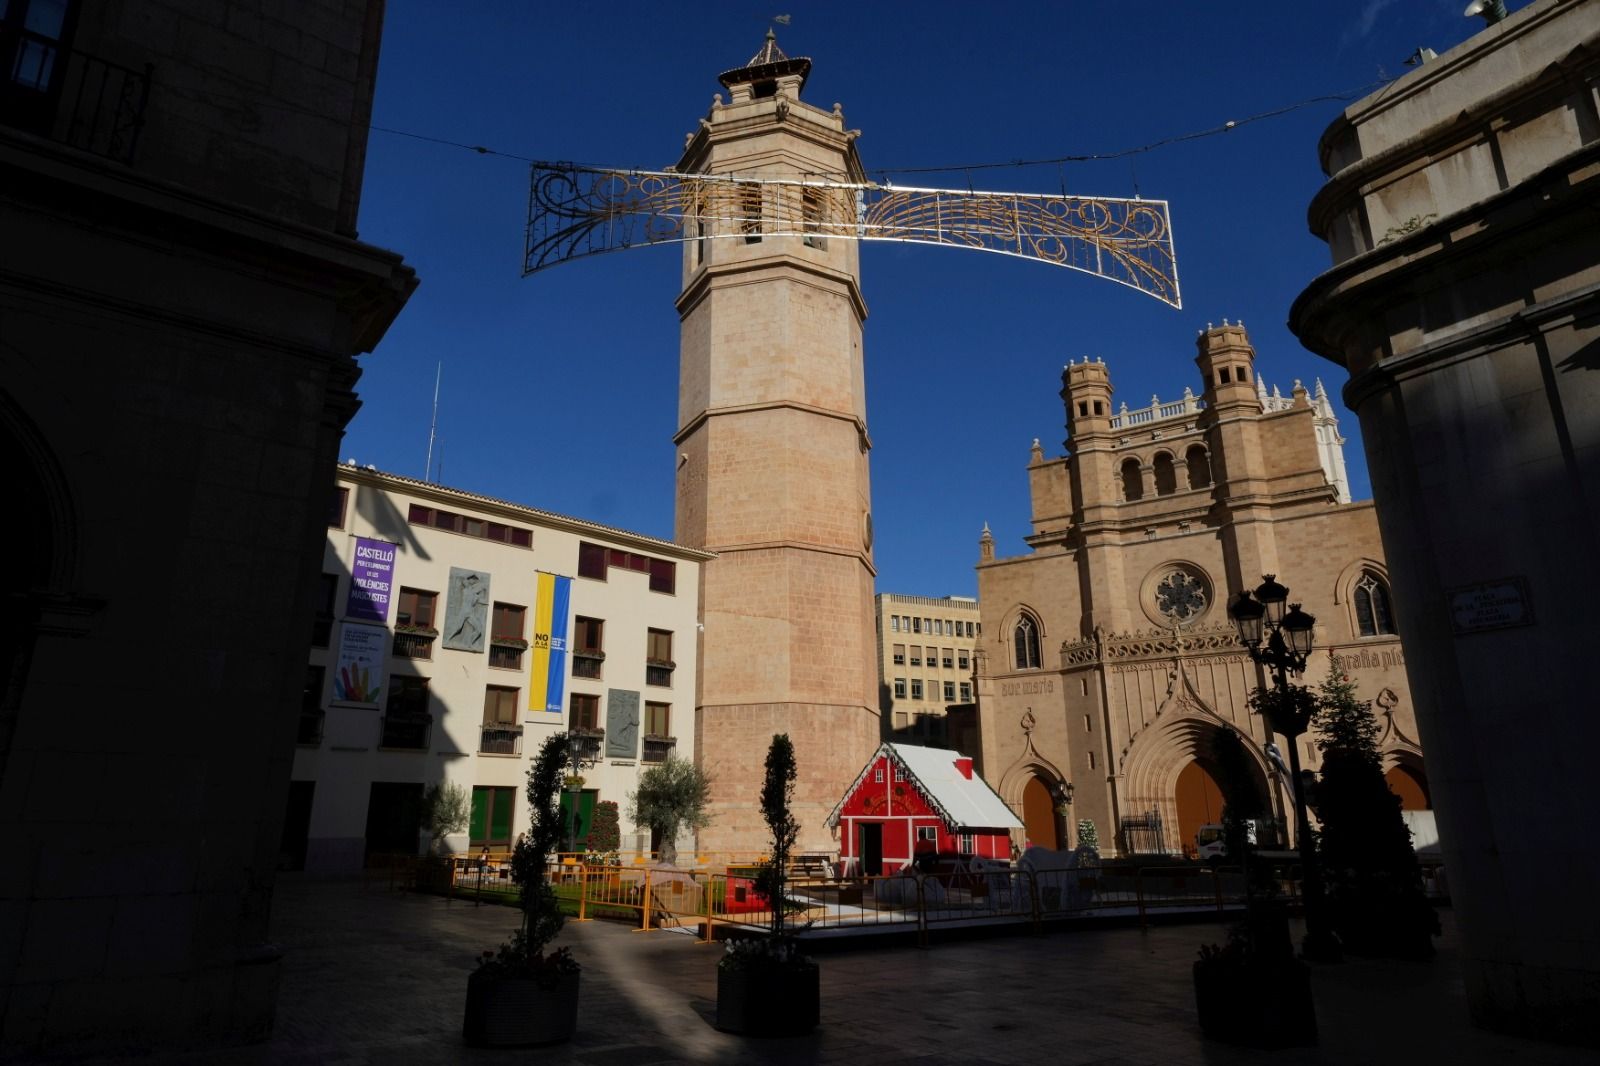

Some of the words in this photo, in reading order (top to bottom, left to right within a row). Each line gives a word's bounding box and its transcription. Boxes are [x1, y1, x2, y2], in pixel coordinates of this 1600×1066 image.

[357, 546, 393, 562] CASTELLÓ
[354, 578, 389, 591] VIOLÈNCIES
[352, 591, 388, 603] MASCLISTES
[536, 633, 549, 641] NO
